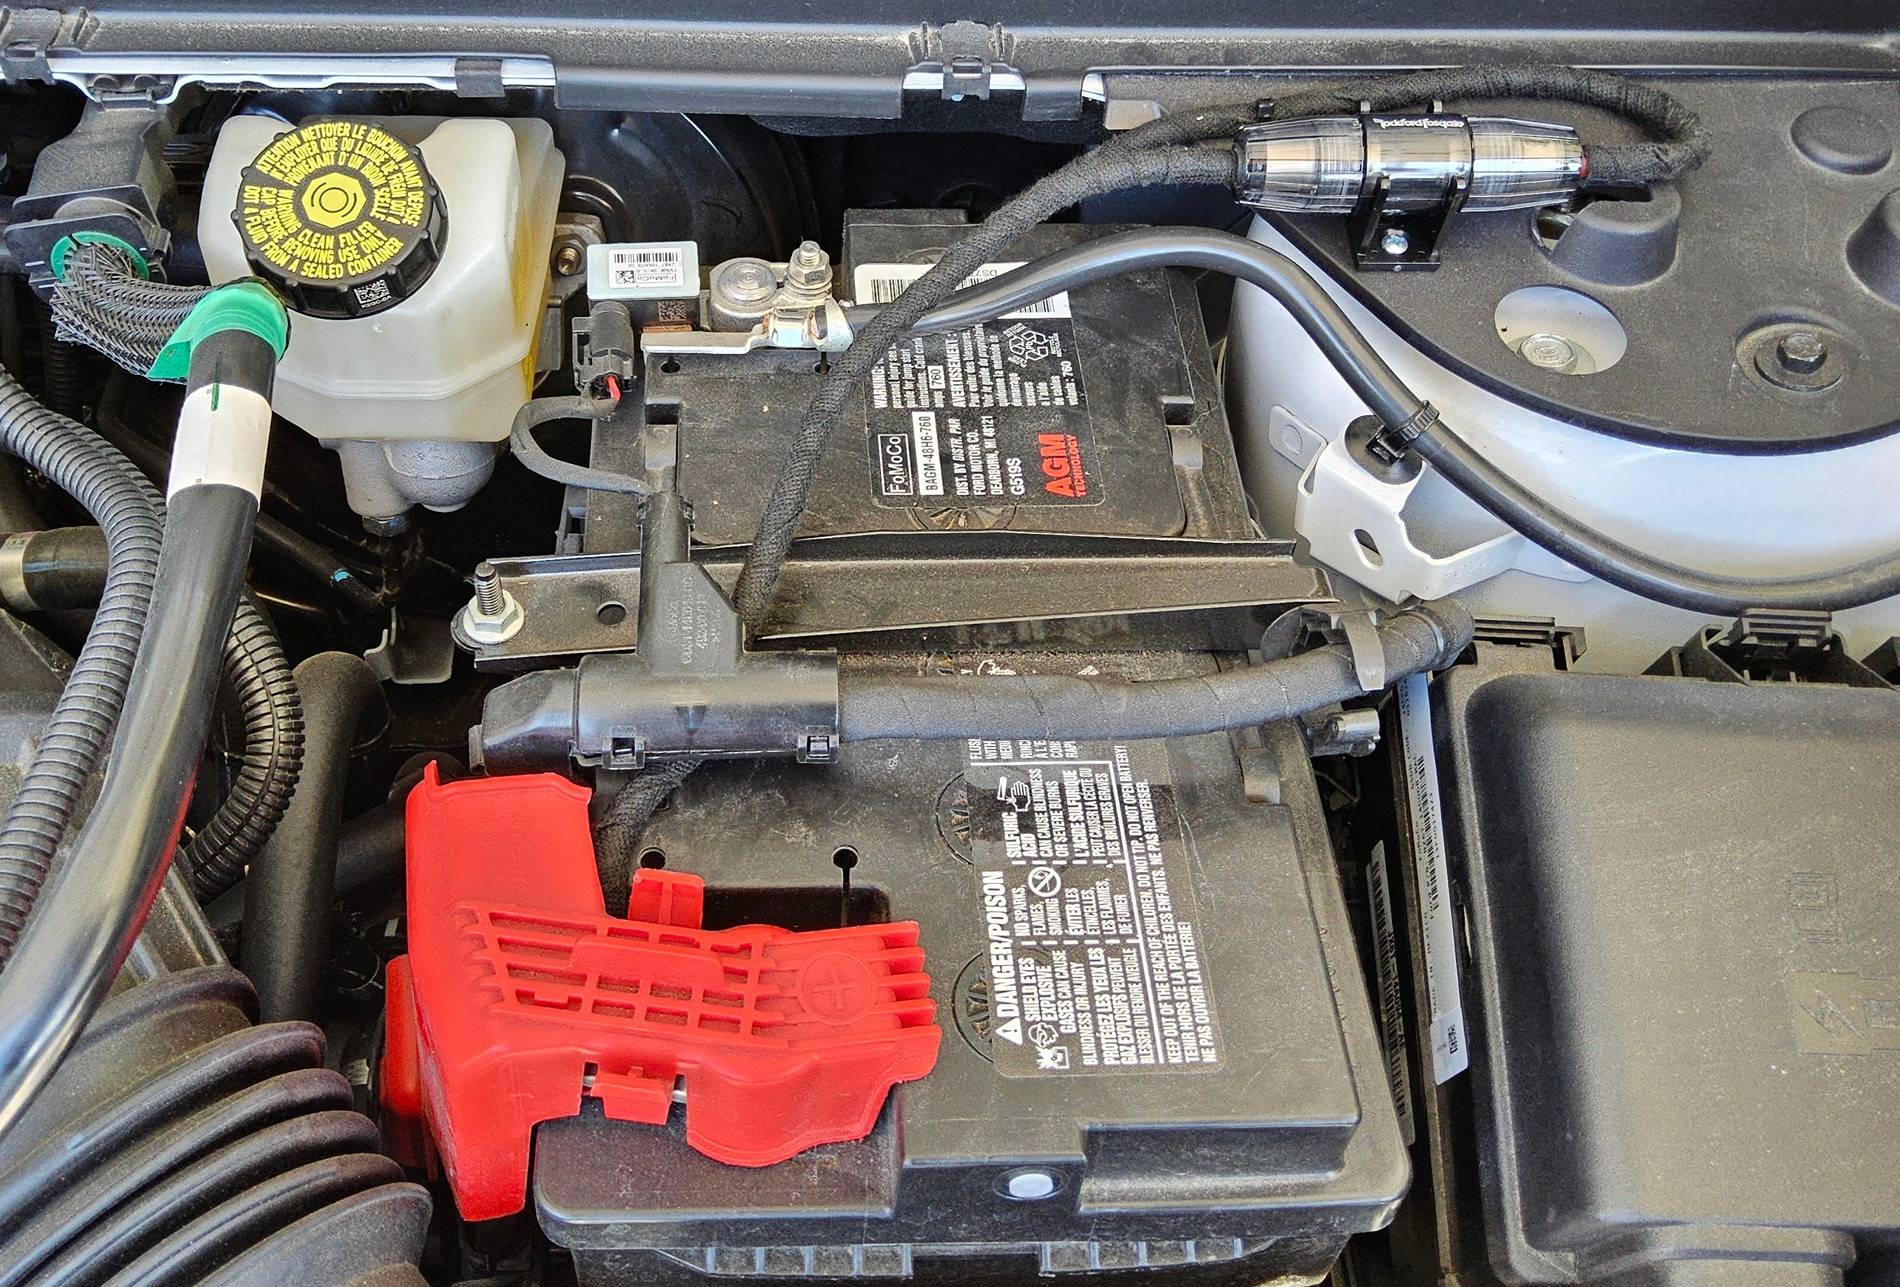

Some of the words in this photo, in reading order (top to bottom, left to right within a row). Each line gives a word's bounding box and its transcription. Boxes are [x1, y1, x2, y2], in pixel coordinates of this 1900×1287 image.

[256, 133, 301, 174] ATTENTION
[301, 122, 350, 142] NETTOYER
[353, 124, 367, 139] LE
[367, 128, 409, 162] BOUCHON
[399, 160, 423, 188] AVANT
[320, 137, 339, 152] QUE
[341, 137, 354, 152] DU
[356, 140, 390, 168] LIQUIDE
[381, 160, 399, 175] DE
[283, 151, 335, 187] PROVENANT
[361, 161, 386, 188] BIDON
[243, 185, 261, 205] DOT
[260, 187, 278, 206] CAP
[244, 216, 269, 245] FLUID
[260, 207, 290, 243] BEFORE
[277, 190, 302, 235] WARNING
[297, 228, 335, 249] CLEAN
[339, 220, 378, 248] FILLER
[260, 242, 292, 268] FROM
[281, 238, 335, 264] REMOVING
[338, 247, 361, 264] USE
[360, 231, 388, 255] ONLY
[288, 259, 300, 273] A
[347, 236, 405, 277] CONTAINER
[300, 261, 344, 280] SEALED
[913, 355, 926, 369] Cold
[964, 361, 976, 373] des
[1061, 361, 1074, 377] 760
[871, 365, 888, 409] WARNING:
[931, 368, 942, 386] 760
[947, 418, 962, 435] PAR
[966, 429, 980, 443] CO.
[950, 436, 965, 461] DISTR.
[984, 438, 997, 449] MI
[886, 436, 907, 493] FoMoCo
[953, 463, 967, 474] BY
[968, 444, 984, 472] MOTOR
[1038, 433, 1075, 497] AGM
[1067, 434, 1086, 497] TECHNOLOGY
[955, 475, 969, 496] DIST.
[972, 474, 986, 496] FORD
[986, 450, 1004, 495] DEARBORN,
[1006, 458, 1025, 496] G519S
[983, 740, 998, 760] WITH
[1114, 745, 1133, 781] BATTERY!
[1079, 767, 1093, 778] OU
[1028, 768, 1047, 811] BLINDNESS
[1045, 780, 1063, 809] BURNS
[1062, 769, 1084, 822] SULFURIQUE
[1095, 772, 1112, 801] GRAVES
[1121, 782, 1138, 804] OPEN
[1084, 801, 1099, 810] LA
[1124, 804, 1141, 822] NOT
[1136, 779, 1158, 832] RENVERSER.
[1002, 812, 1022, 858] SULFURIC
[1034, 812, 1051, 838] CAUSE
[1050, 810, 1069, 843] SEVERE
[1085, 810, 1103, 838] CAUSER
[1127, 823, 1143, 836] DO
[1021, 833, 1038, 857] ACID
[1039, 840, 1054, 857] CAN
[1055, 844, 1069, 857] OR
[1070, 822, 1090, 858] L'ACIDE
[1090, 838, 1106, 856] PEUT
[1105, 841, 1121, 857] DES
[1130, 838, 1147, 855] TIP.
[1143, 832, 1161, 852] PAS
[1133, 855, 1150, 873] NOT
[1149, 853, 1163, 866] NE
[1137, 874, 1152, 887] DO
[1152, 867, 1173, 912] ENFANTS.
[1012, 884, 1029, 921] SPARKS,
[1065, 888, 1080, 902] LES
[1096, 878, 1115, 919] FLAMMES,
[1113, 894, 1131, 921] FUMER
[1030, 901, 1047, 935] FLAMES,
[1045, 898, 1063, 936] SMOKING
[1065, 904, 1085, 935] ÉVITER
[1081, 887, 1101, 935] ÉTINCELLES,
[1139, 889, 1161, 936] CHILDREN.
[1159, 914, 1176, 932] DES
[1013, 922, 1030, 936] NO
[1102, 920, 1117, 935] LES
[1118, 921, 1133, 934] DE
[982, 870, 1020, 1018] DANGER/POISON
[1088, 947, 1105, 965] LES
[1147, 937, 1164, 950] OF
[1162, 934, 1183, 970] PORTÉE
[1176, 922, 1199, 970] BATTERIE!
[1018, 957, 1038, 984] EYES
[1052, 949, 1069, 979] CAUSE
[1107, 956, 1126, 993] PEUVENT
[1122, 947, 1142, 982] AVEUGLE
[1150, 951, 1168, 981] REACH
[1186, 970, 1203, 984] LA
[1055, 979, 1073, 999] CAN
[1070, 962, 1088, 995] INJURY
[1090, 966, 1109, 992] YEUX
[1169, 971, 1185, 985] LA
[1021, 985, 1041, 1022] SHIELD
[1036, 965, 1058, 1021] EXPLOSIVE
[1075, 996, 1091, 1010] OR
[1095, 993, 1112, 1012] LES
[1128, 982, 1147, 1014] RENDRE
[1155, 982, 1171, 1002] THE
[1173, 986, 1188, 1001] DE
[1190, 986, 1210, 1024] OUVRIR
[1057, 1000, 1077, 1034] GASES
[1111, 993, 1135, 1044] EXPLOSIFS
[1133, 1015, 1149, 1028] OU
[1159, 1003, 1175, 1016] OF
[1175, 1002, 1194, 1031] HORS
[1078, 1012, 1098, 1065] BLINDNESS
[1096, 1014, 1120, 1065] PROTÉGEZ
[1161, 1017, 1178, 1037] OUT
[1197, 1025, 1214, 1046] PAS
[1119, 1045, 1138, 1065] GAZ
[1135, 1029, 1155, 1064] BLESSER
[1166, 1039, 1183, 1063] KEEP
[1180, 1032, 1200, 1062] TENIR
[1202, 1047, 1217, 1061] NE
